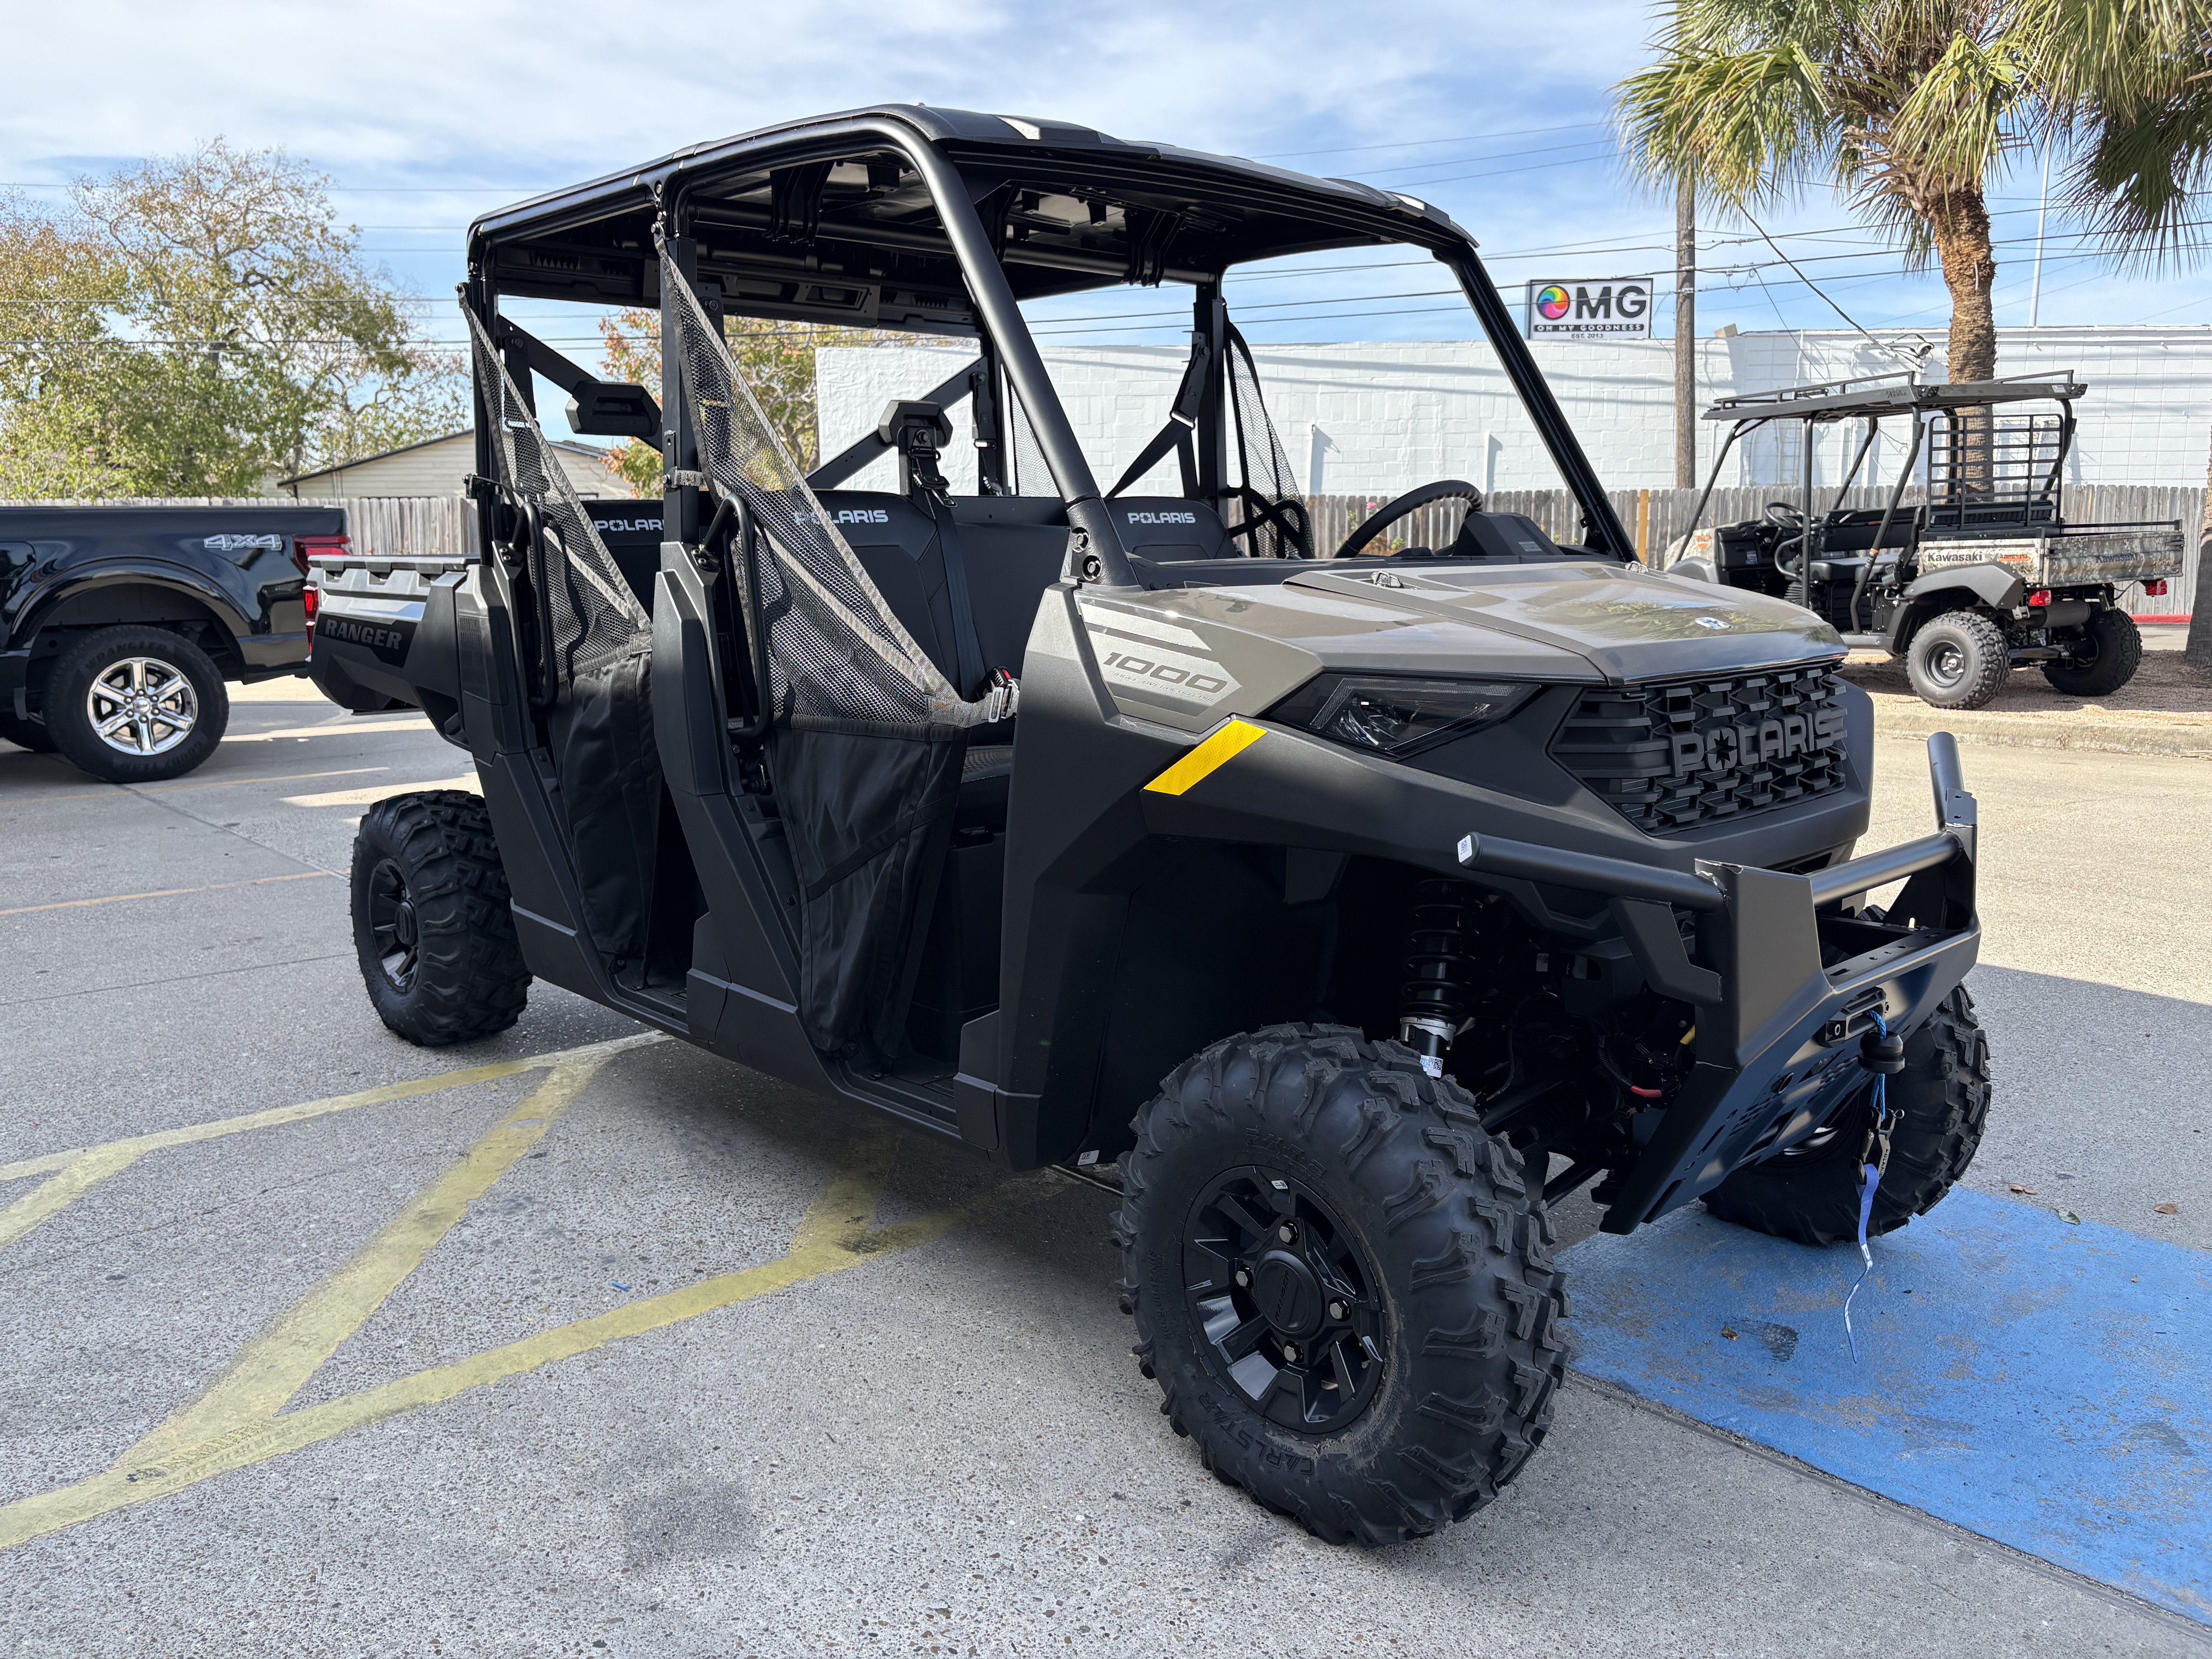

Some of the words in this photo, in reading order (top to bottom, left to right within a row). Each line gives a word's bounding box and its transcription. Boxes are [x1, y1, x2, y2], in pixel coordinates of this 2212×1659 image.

[1127, 512, 1196, 524] POLARIS
[594, 519, 664, 532] POLAR
[1928, 551, 1982, 562] Kawasaki
[2096, 553, 2138, 563] Kawasaki
[325, 619, 403, 651] RANGER
[1103, 652, 1228, 694] 1000
[1668, 707, 1835, 777] POLARIS
